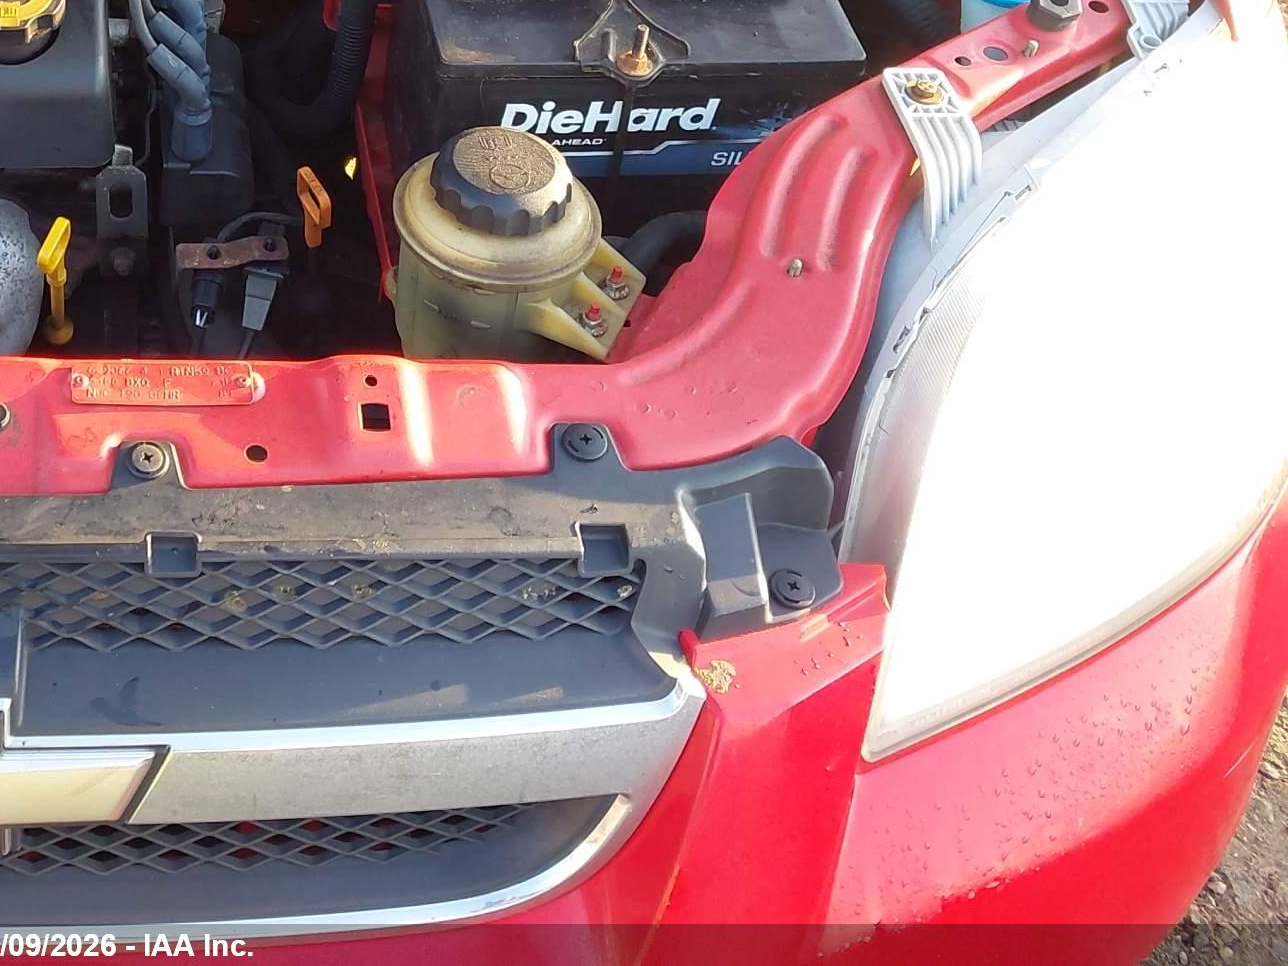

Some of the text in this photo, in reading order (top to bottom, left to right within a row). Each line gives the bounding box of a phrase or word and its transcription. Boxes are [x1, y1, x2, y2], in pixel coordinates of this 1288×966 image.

[500, 97, 722, 135] DieHard
[551, 137, 605, 147] AHEAD
[710, 150, 751, 166] SIL
